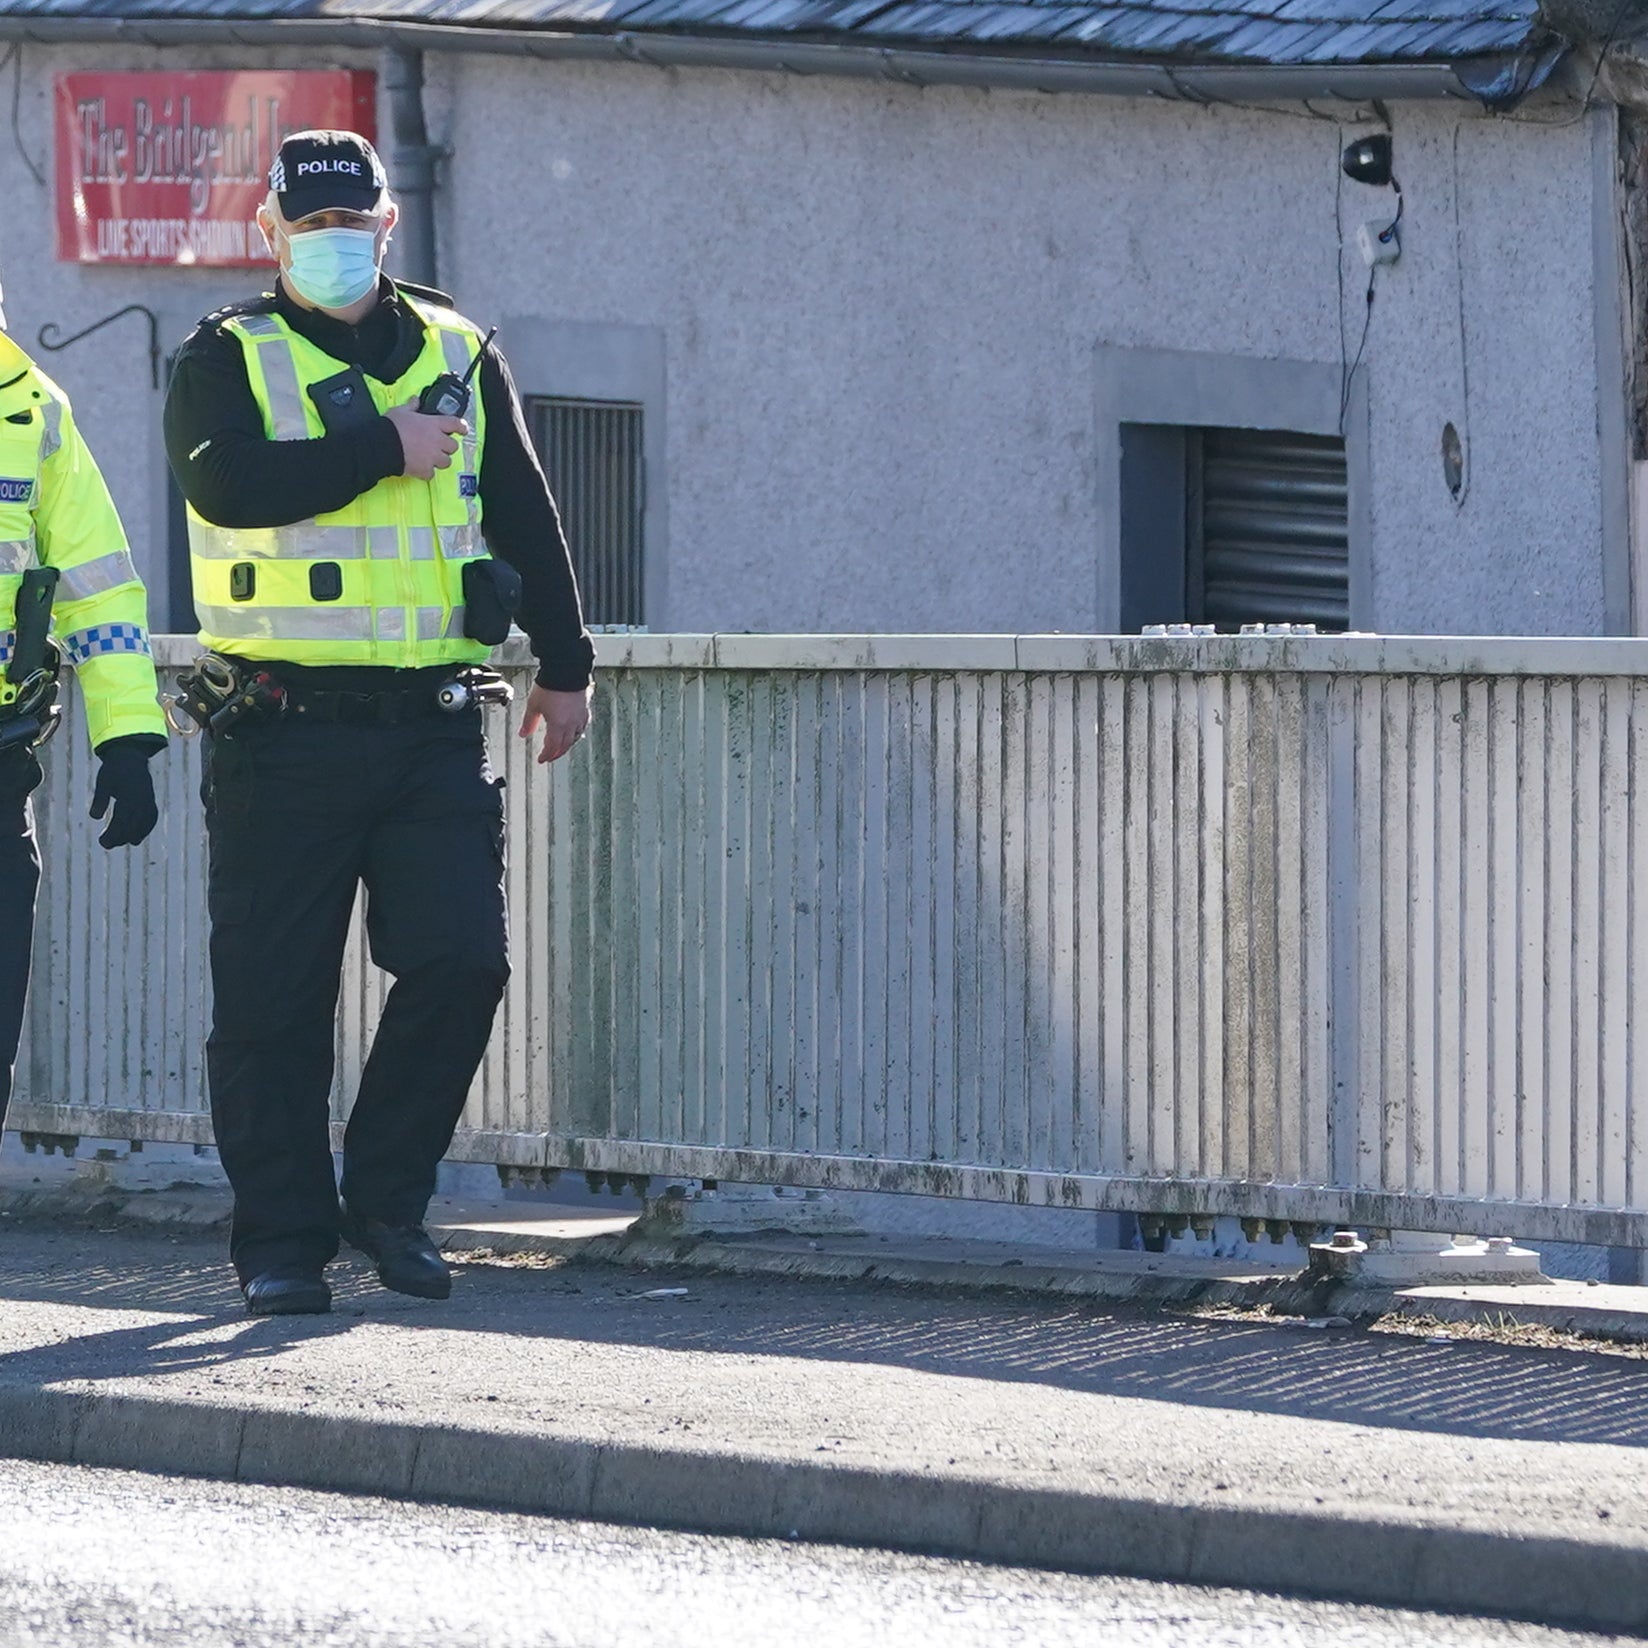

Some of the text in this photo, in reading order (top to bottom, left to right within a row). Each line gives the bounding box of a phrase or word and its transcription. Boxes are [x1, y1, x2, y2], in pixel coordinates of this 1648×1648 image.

[77, 97, 127, 186] The
[134, 95, 261, 216] Bridgend
[297, 159, 362, 177] POLICE
[98, 218, 129, 257] LIVE
[130, 219, 187, 259] SPORTS
